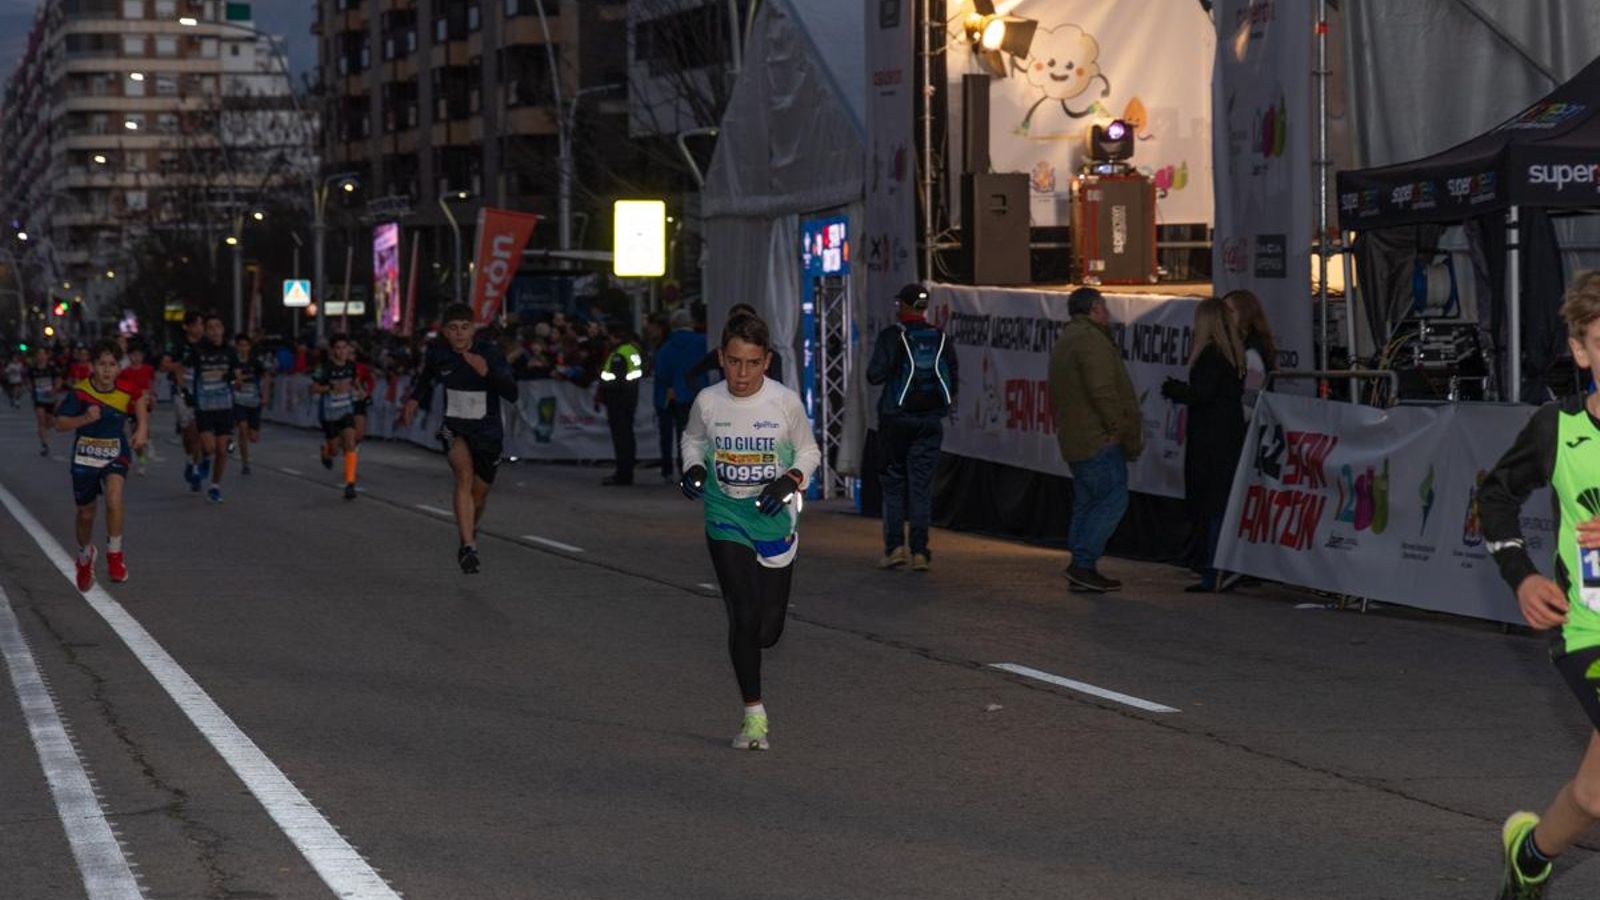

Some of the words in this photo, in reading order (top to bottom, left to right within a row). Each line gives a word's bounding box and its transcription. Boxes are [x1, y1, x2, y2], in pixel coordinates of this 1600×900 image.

[1131, 324, 1178, 365] NOCHE
[735, 437, 776, 451] GILETE
[715, 463, 776, 481] 10956
[1280, 431, 1338, 489] SAN
